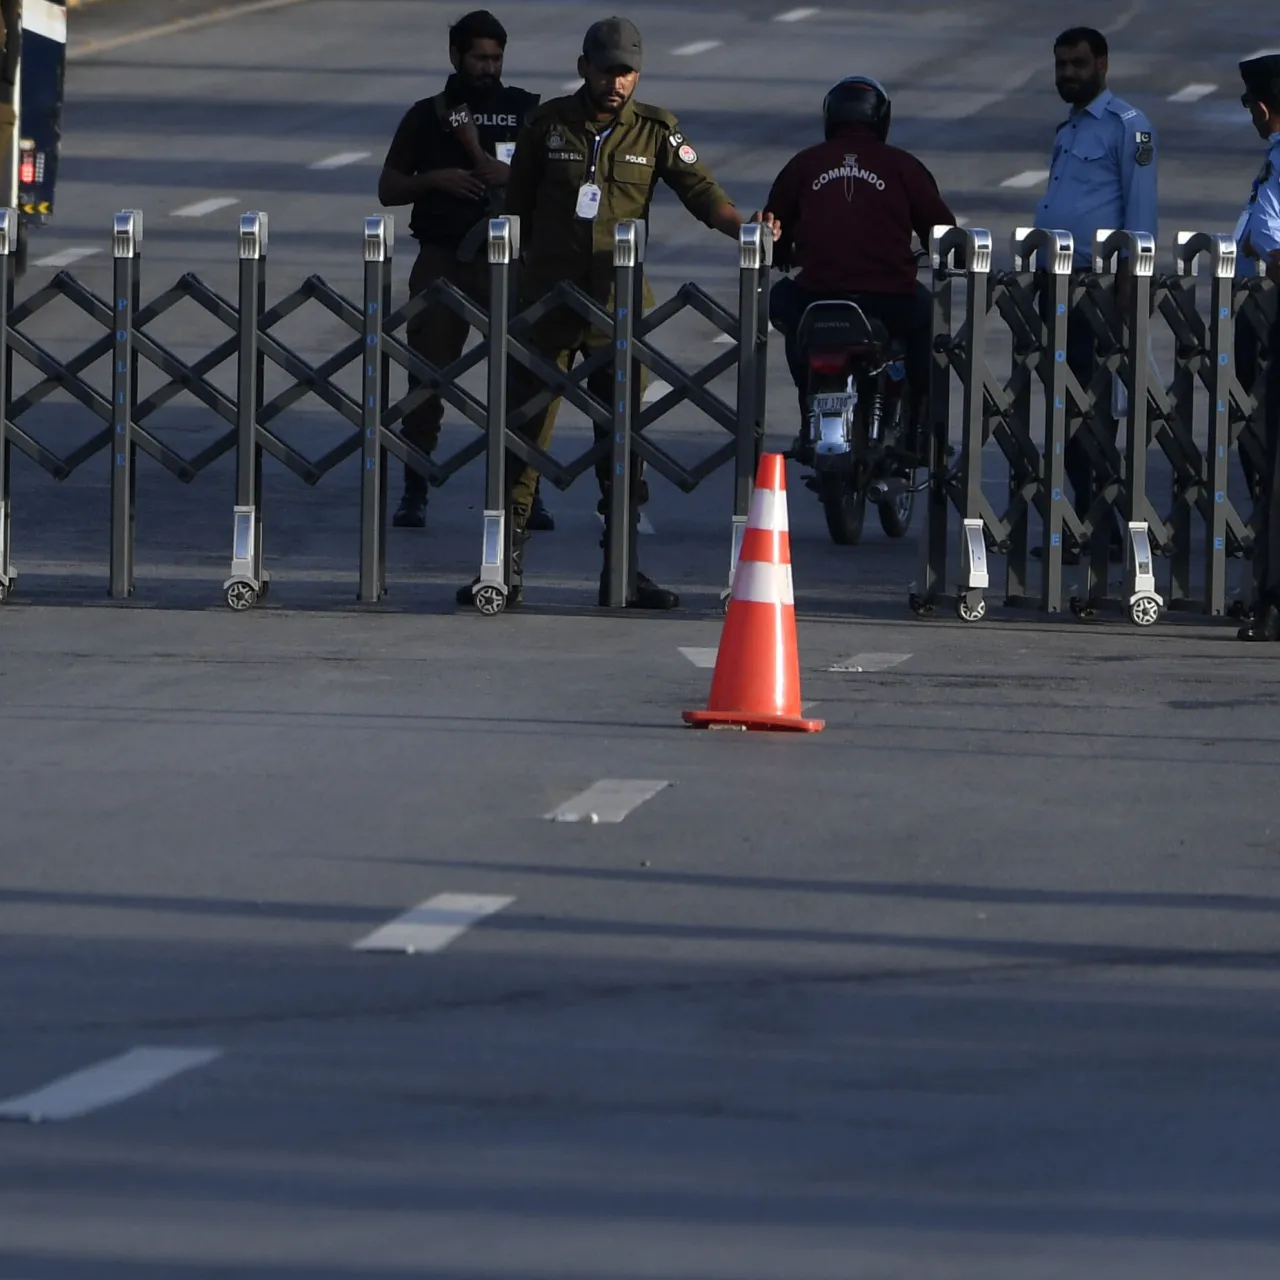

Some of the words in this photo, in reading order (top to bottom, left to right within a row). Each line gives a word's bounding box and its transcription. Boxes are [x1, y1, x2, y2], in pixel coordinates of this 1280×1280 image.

[472, 113, 517, 126] OLICE
[624, 154, 648, 164] POLICE
[812, 166, 886, 191] COMMANDO
[114, 296, 128, 467] POLICE
[365, 300, 379, 471] POLICE
[614, 305, 629, 475] POLICE
[1050, 302, 1067, 546] POLICE
[1212, 305, 1230, 550] POLICE
